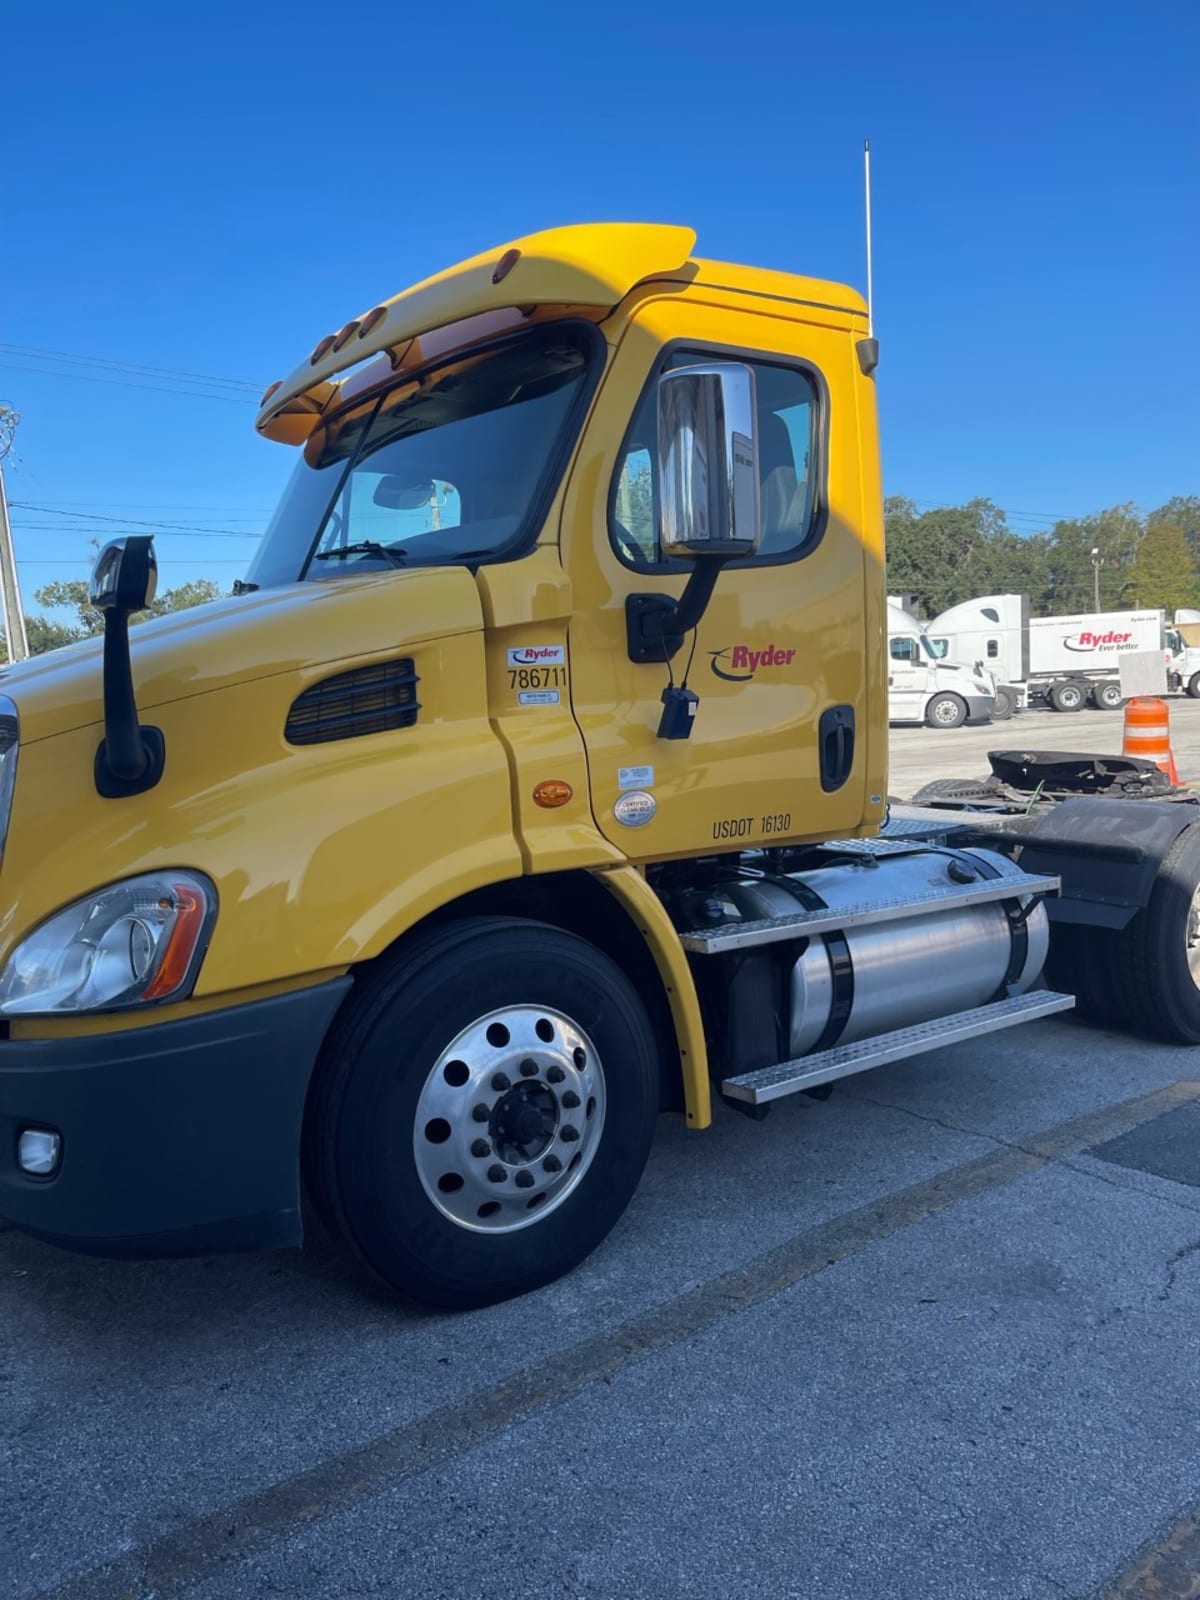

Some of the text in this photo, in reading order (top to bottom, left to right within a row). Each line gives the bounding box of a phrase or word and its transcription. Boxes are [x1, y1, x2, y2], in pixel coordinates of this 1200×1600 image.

[1078, 630, 1132, 647] Ryder
[1098, 644, 1114, 652] Ever
[524, 648, 559, 660] Ryder
[731, 644, 796, 673] Ryder
[507, 667, 566, 689] 786711
[713, 813, 791, 840] USDOT 16130
